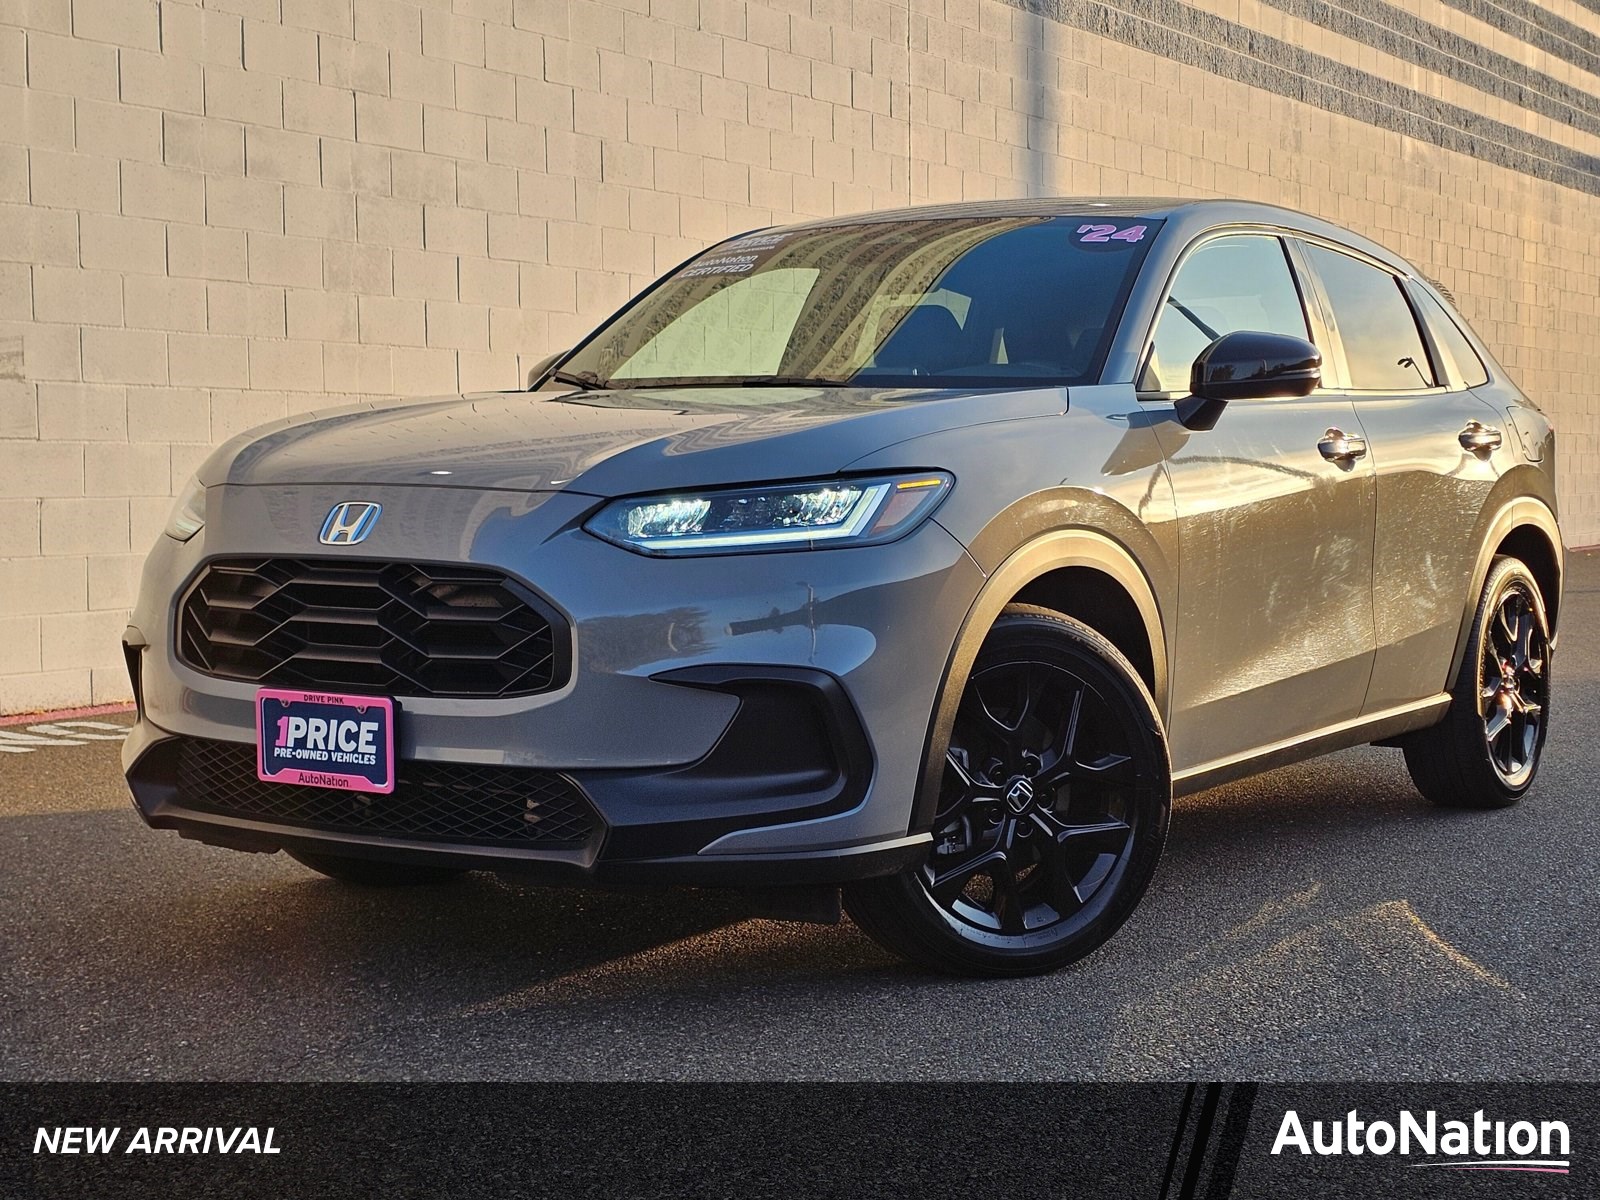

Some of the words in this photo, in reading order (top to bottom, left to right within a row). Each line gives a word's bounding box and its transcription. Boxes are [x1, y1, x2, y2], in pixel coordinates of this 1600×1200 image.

[1077, 224, 1148, 243] '24
[680, 263, 754, 278] CERTIFIED
[303, 694, 325, 703] DRIVE
[327, 696, 345, 705] PINK
[274, 747, 329, 762] PRE-OWNED
[331, 751, 376, 765] VEHICLES
[298, 771, 349, 788] AutoNation
